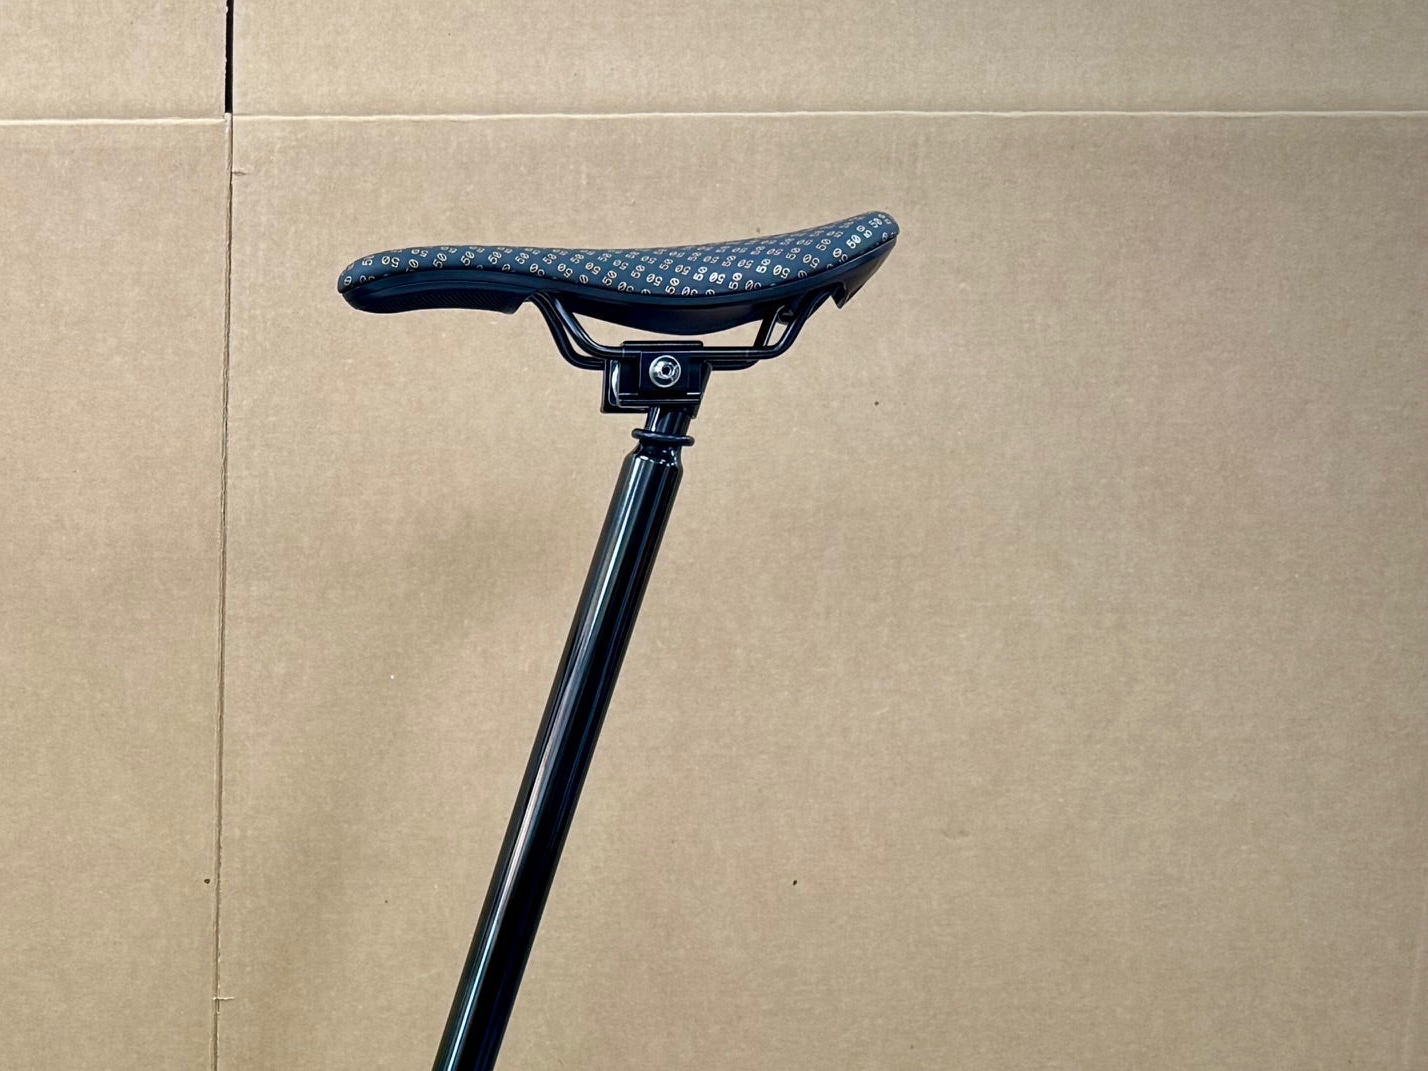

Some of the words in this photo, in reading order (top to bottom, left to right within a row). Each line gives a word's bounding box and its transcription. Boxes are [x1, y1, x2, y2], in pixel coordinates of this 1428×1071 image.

[868, 218, 882, 228] 50
[856, 225, 872, 238] 50
[816, 239, 831, 251] 50
[846, 235, 861, 249] 50
[461, 251, 475, 266] 50
[488, 251, 502, 264] 50
[515, 253, 529, 264] 50
[543, 254, 557, 264] 50
[571, 254, 584, 264] 50
[642, 256, 657, 264] 50
[786, 248, 800, 260] 50
[382, 256, 400, 268] 50
[433, 253, 447, 269] 50
[613, 260, 629, 270] 50
[659, 259, 673, 270] 50
[722, 256, 736, 267] 50
[738, 260, 753, 268] 50
[756, 259, 771, 273] 50
[803, 254, 819, 269] 50
[558, 263, 572, 278] 50
[585, 262, 601, 275] 50
[631, 265, 645, 278] 50
[675, 265, 691, 275] 50
[693, 266, 707, 281] 50
[773, 265, 790, 279] 50
[602, 270, 617, 286] 50
[646, 274, 663, 286] 50
[709, 272, 725, 284] 50
[729, 273, 742, 290] 50
[665, 278, 679, 294] 50
